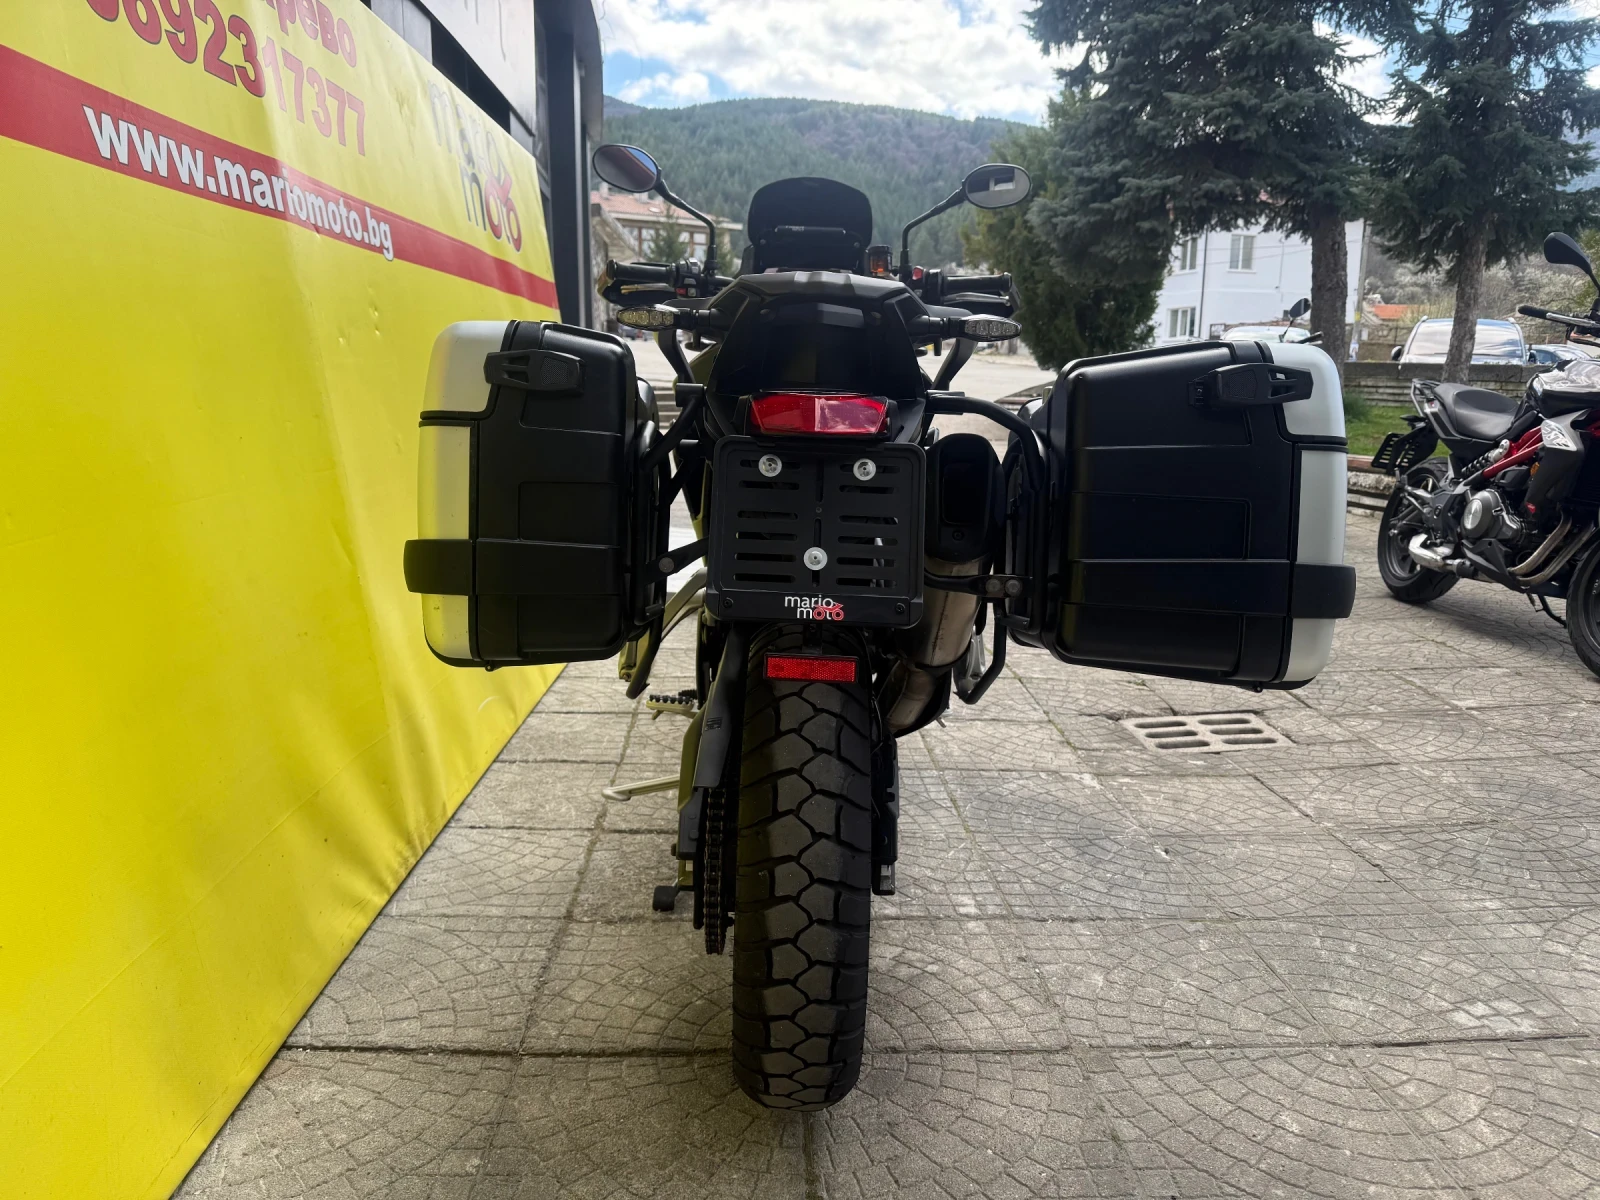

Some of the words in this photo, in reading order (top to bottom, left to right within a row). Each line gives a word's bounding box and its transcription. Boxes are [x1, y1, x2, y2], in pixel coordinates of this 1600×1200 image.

[266, 0, 357, 68] рево
[86, 0, 366, 157] 92317377
[82, 104, 395, 262] www.mariomoto.bg
[784, 594, 834, 608] mario
[796, 606, 845, 621] moto
